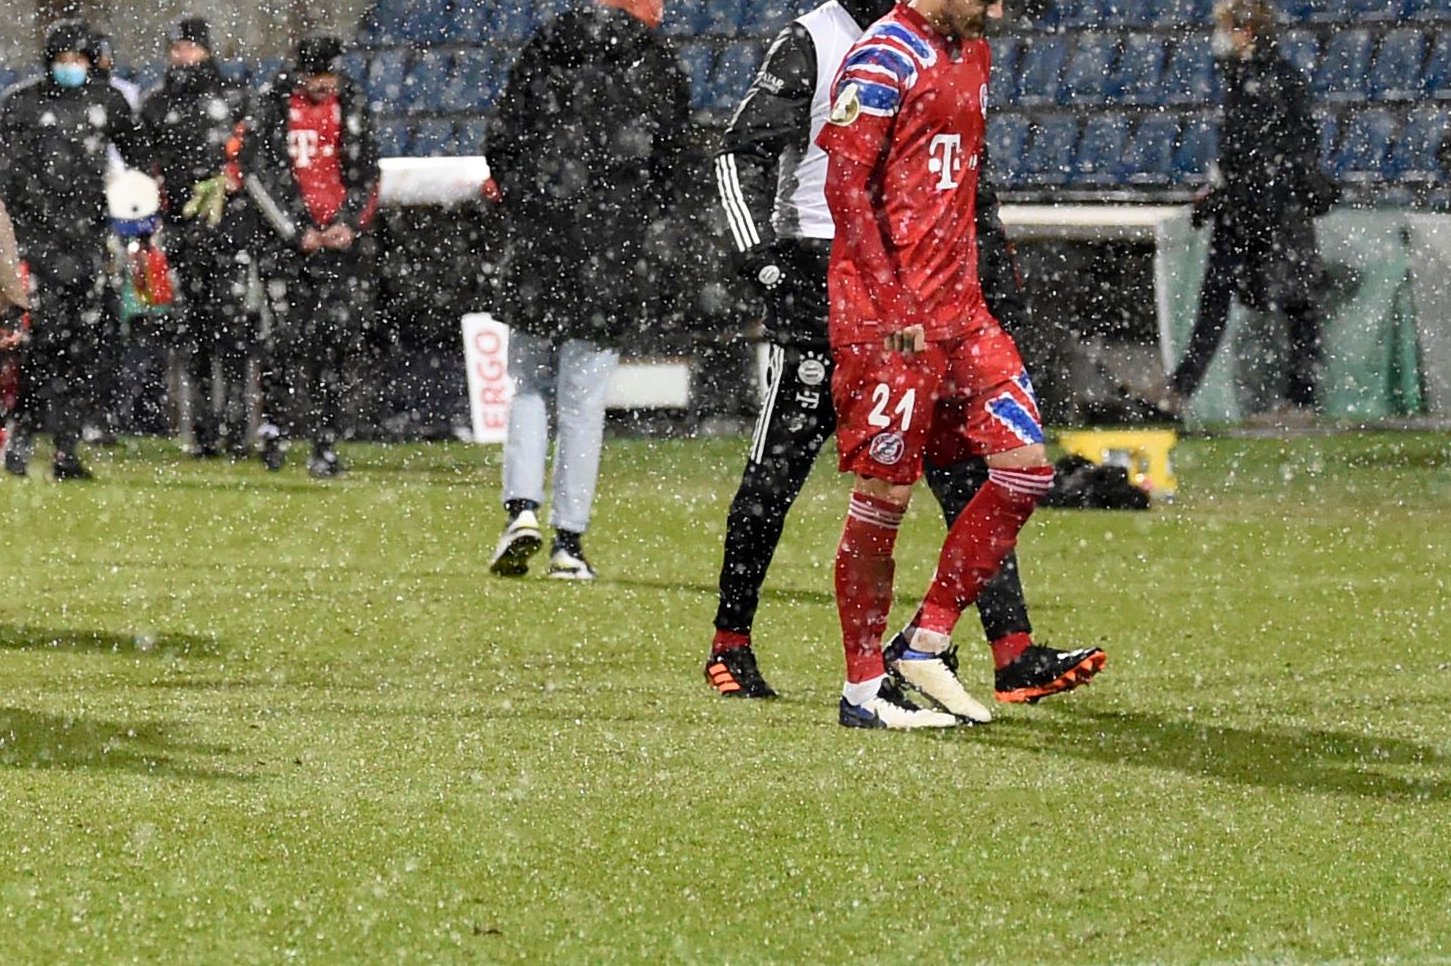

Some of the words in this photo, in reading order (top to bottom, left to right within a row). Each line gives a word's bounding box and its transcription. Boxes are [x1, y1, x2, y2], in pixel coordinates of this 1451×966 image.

[288, 130, 318, 168] T
[928, 133, 961, 189] T
[474, 330, 509, 429] ERGO
[868, 383, 916, 431] 21
